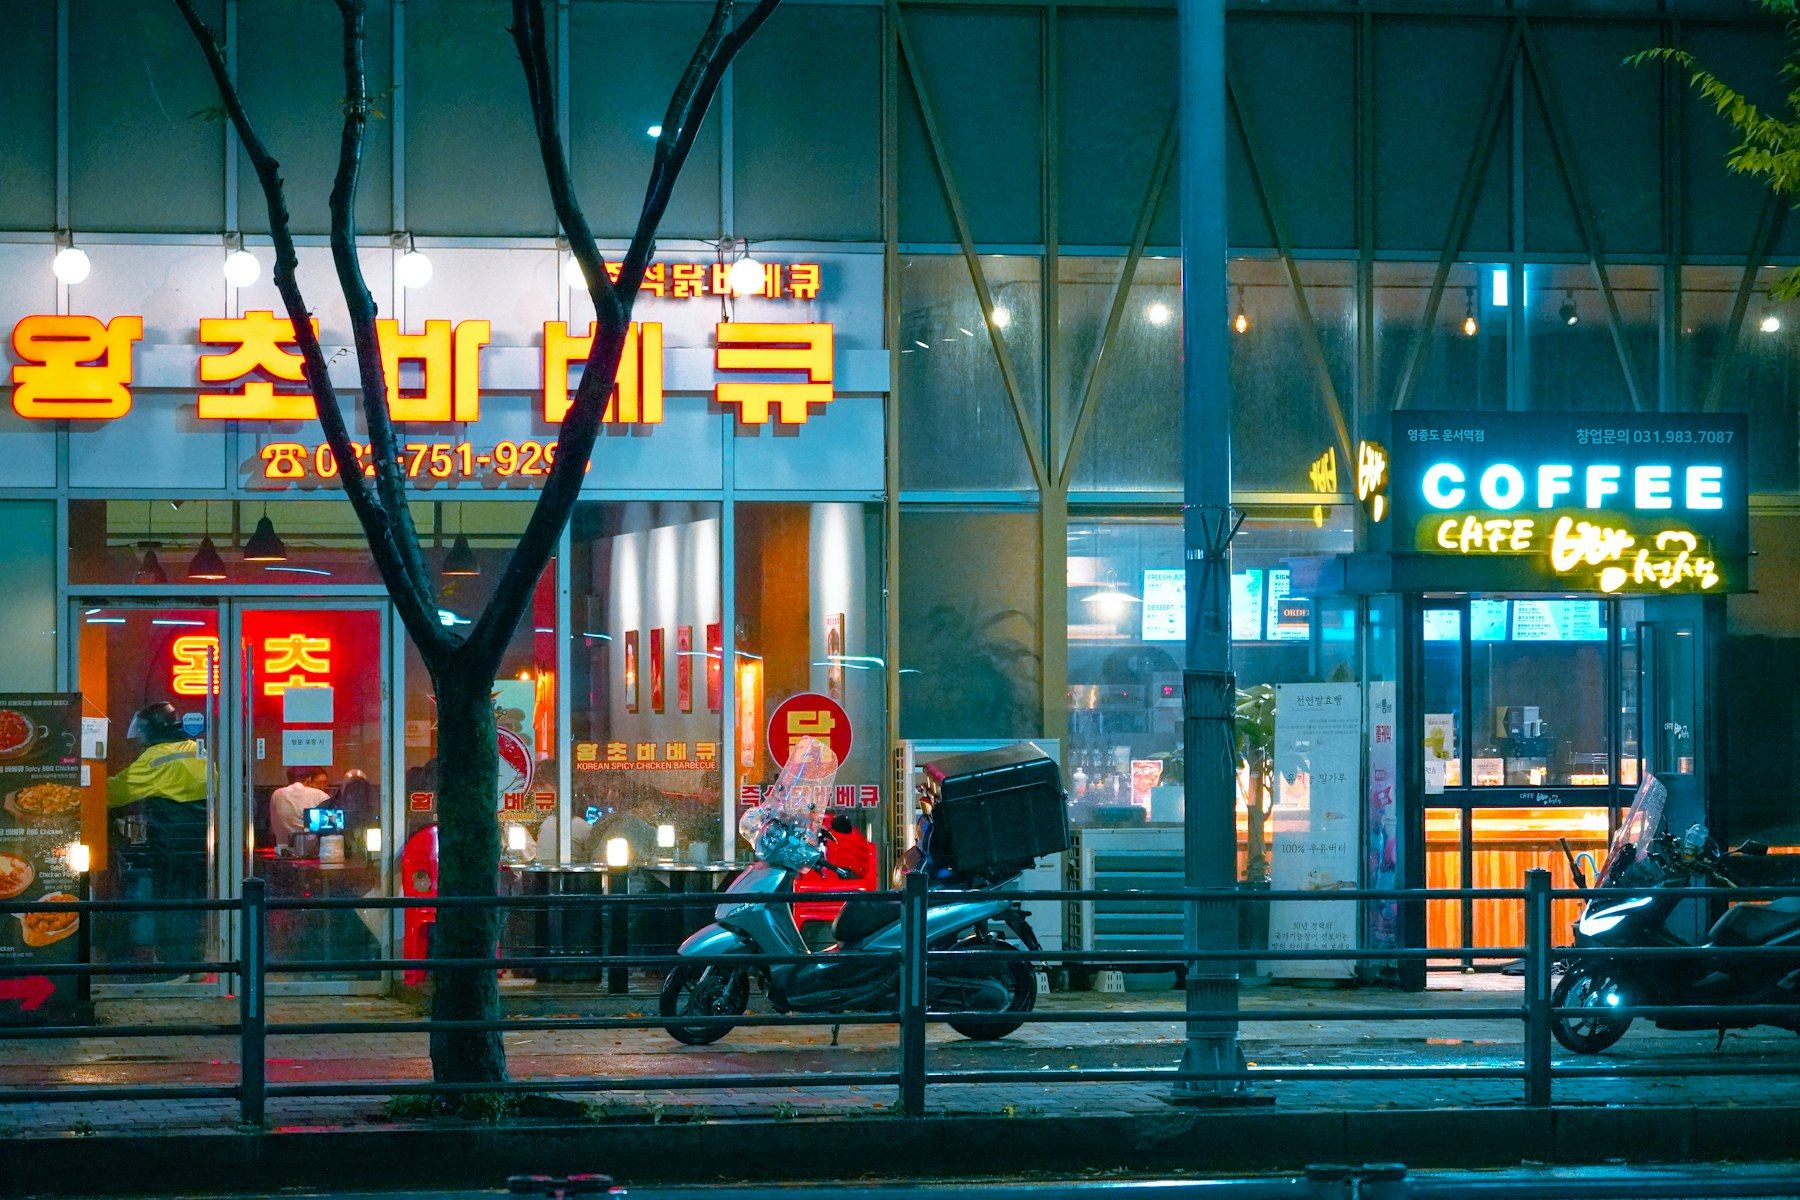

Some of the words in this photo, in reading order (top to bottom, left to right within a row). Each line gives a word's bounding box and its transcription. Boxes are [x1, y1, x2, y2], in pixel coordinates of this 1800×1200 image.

[1407, 429, 1440, 442] 영종도
[1442, 428, 1485, 442] 운서역점
[1576, 428, 1630, 445] 창업문의
[1633, 430, 1734, 444] 031.983.7087
[1421, 462, 1724, 510] COFFEE
[1437, 515, 1535, 553] CAFE
[576, 762, 610, 770] KOREAN
[611, 762, 634, 770] SPICY
[673, 761, 716, 769] BARBECUE
[1282, 844, 1305, 854] 100%
